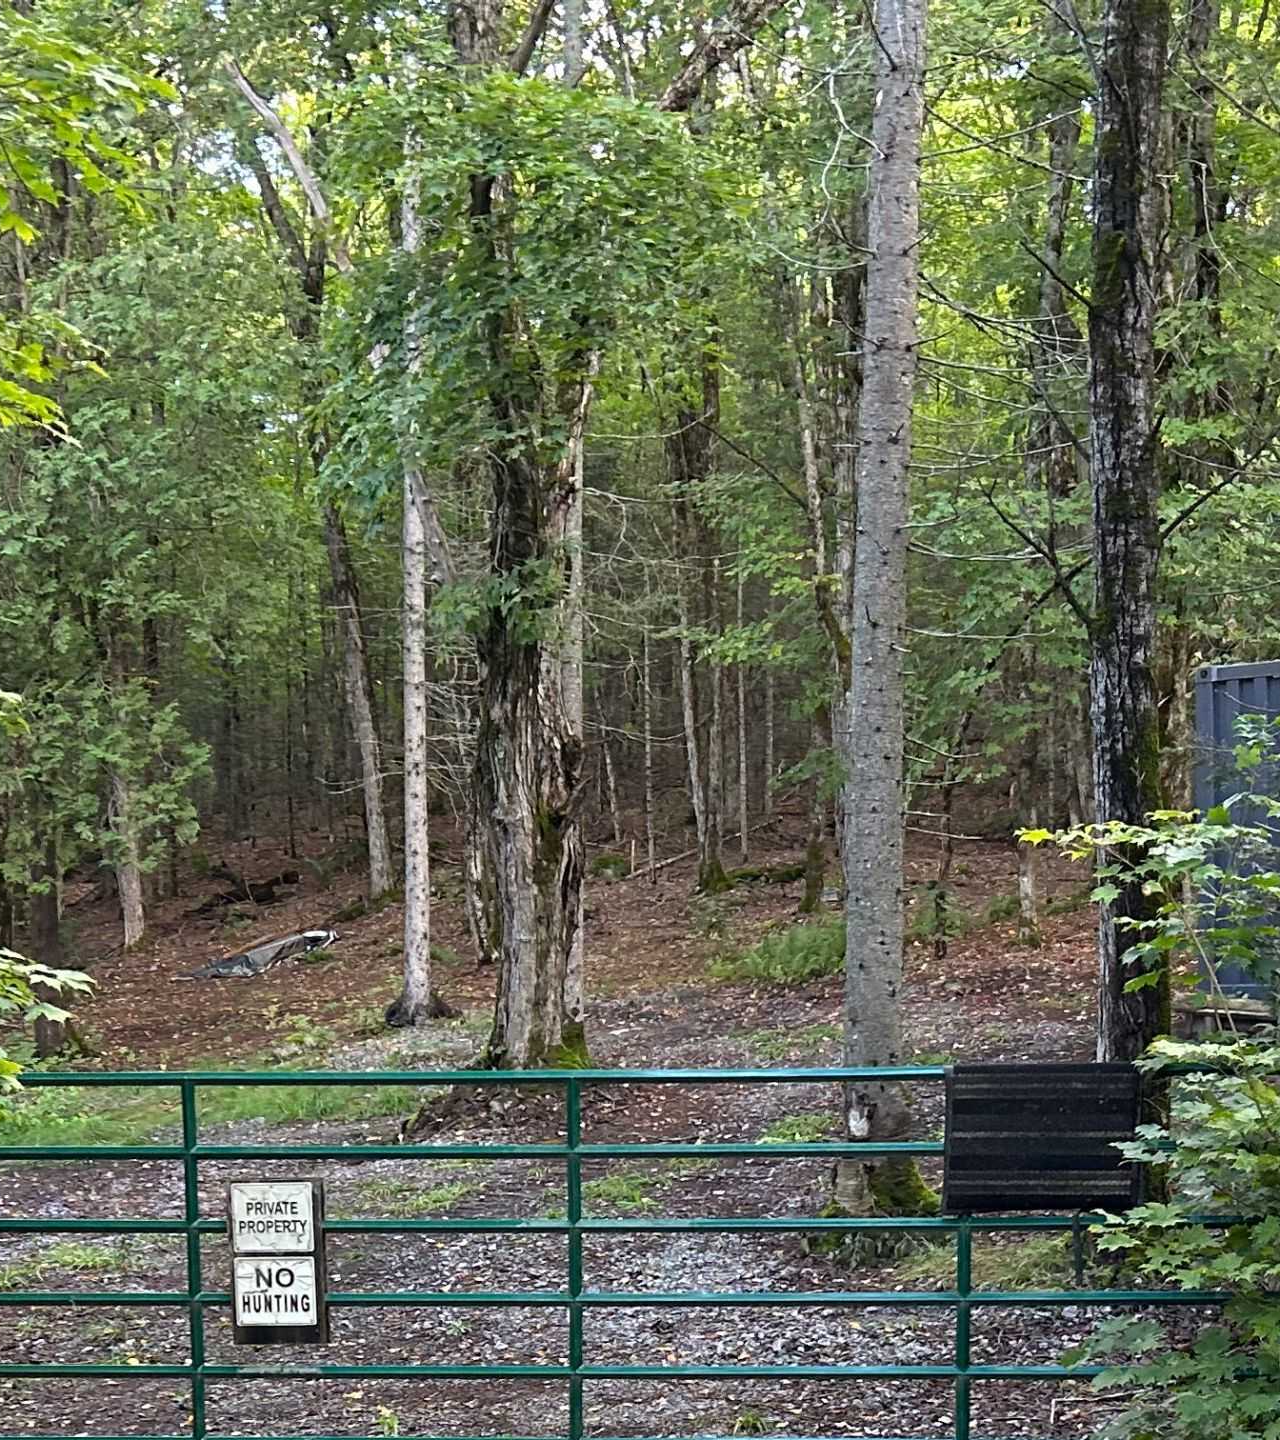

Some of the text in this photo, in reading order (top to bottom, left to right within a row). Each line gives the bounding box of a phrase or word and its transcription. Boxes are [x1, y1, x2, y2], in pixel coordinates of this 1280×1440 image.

[246, 1201, 298, 1216] PRIVATE
[239, 1219, 307, 1234] PROPERTY
[255, 1268, 295, 1288] NO
[242, 1294, 310, 1313] HUNTING
